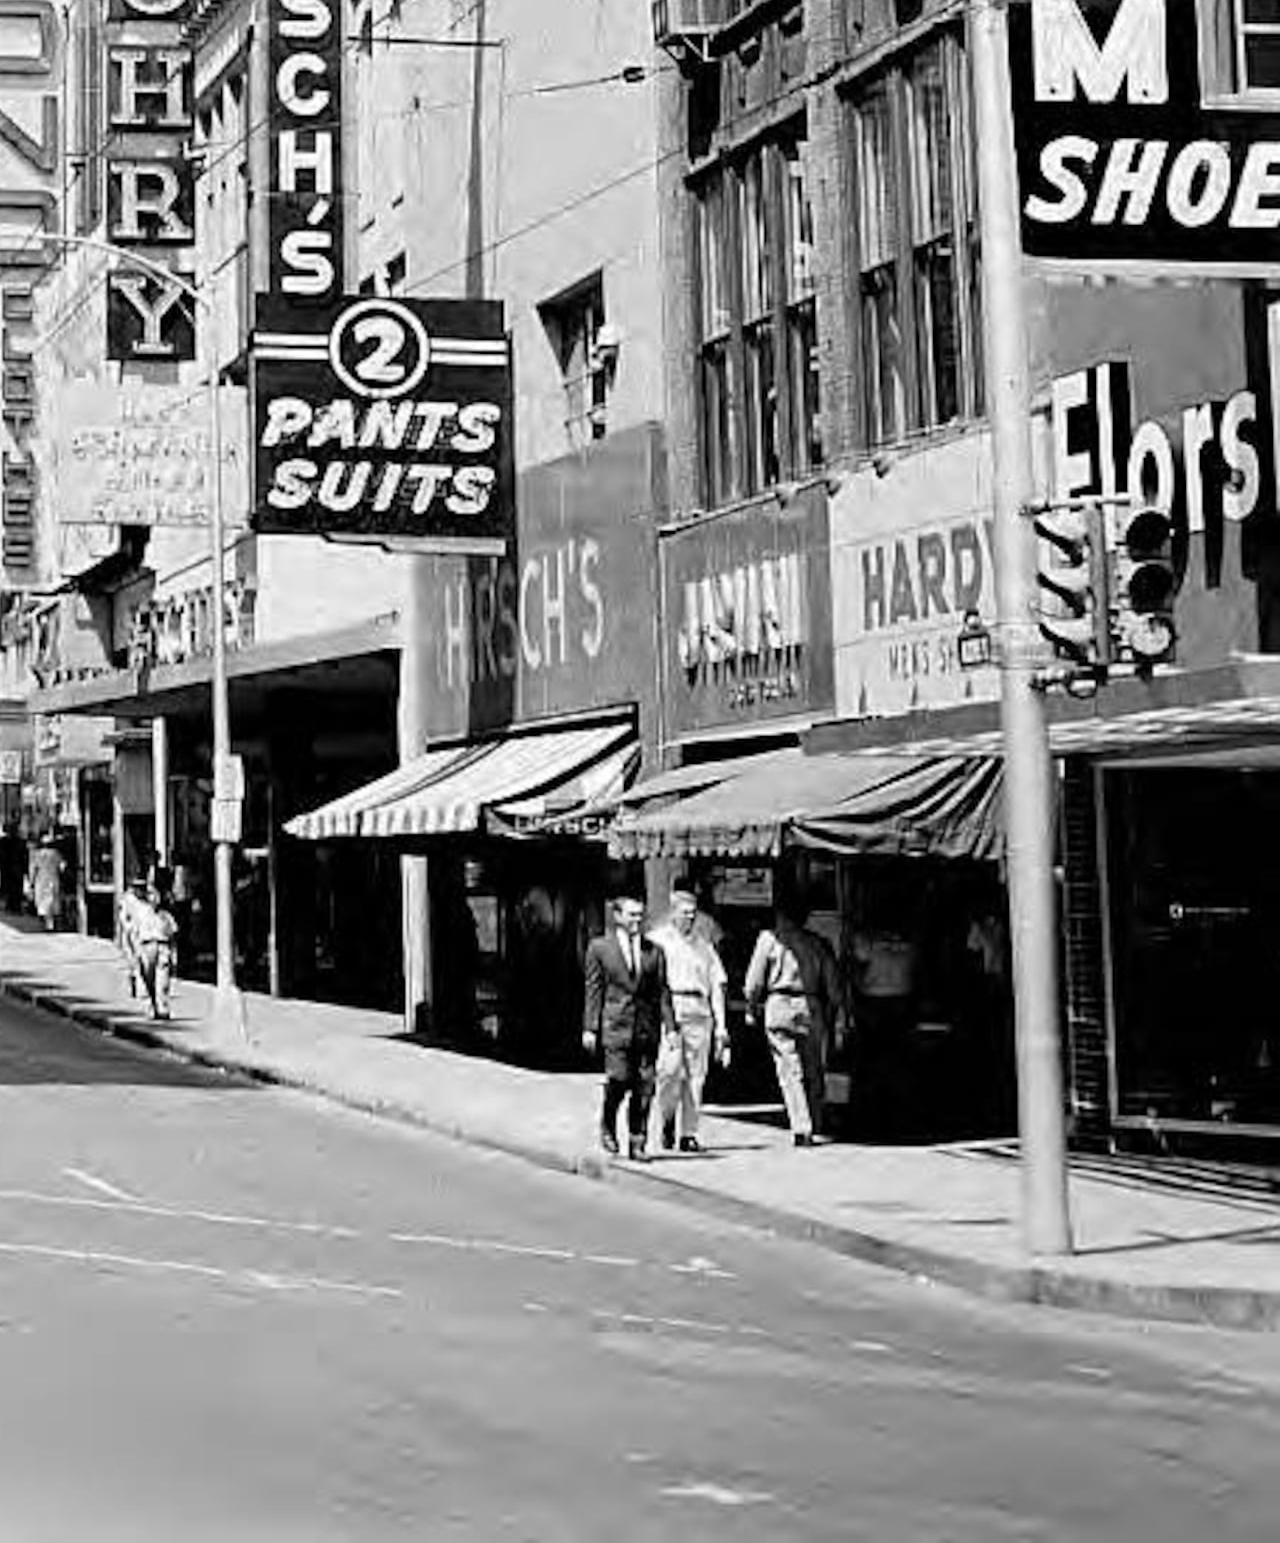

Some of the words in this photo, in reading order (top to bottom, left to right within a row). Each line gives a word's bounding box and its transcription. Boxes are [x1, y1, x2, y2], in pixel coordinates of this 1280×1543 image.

[352, 315, 406, 383] 2
[260, 396, 501, 453] PANTS
[266, 458, 496, 515] SUITS
[861, 522, 996, 632] HARD
[445, 538, 605, 688] HRSCH'S
